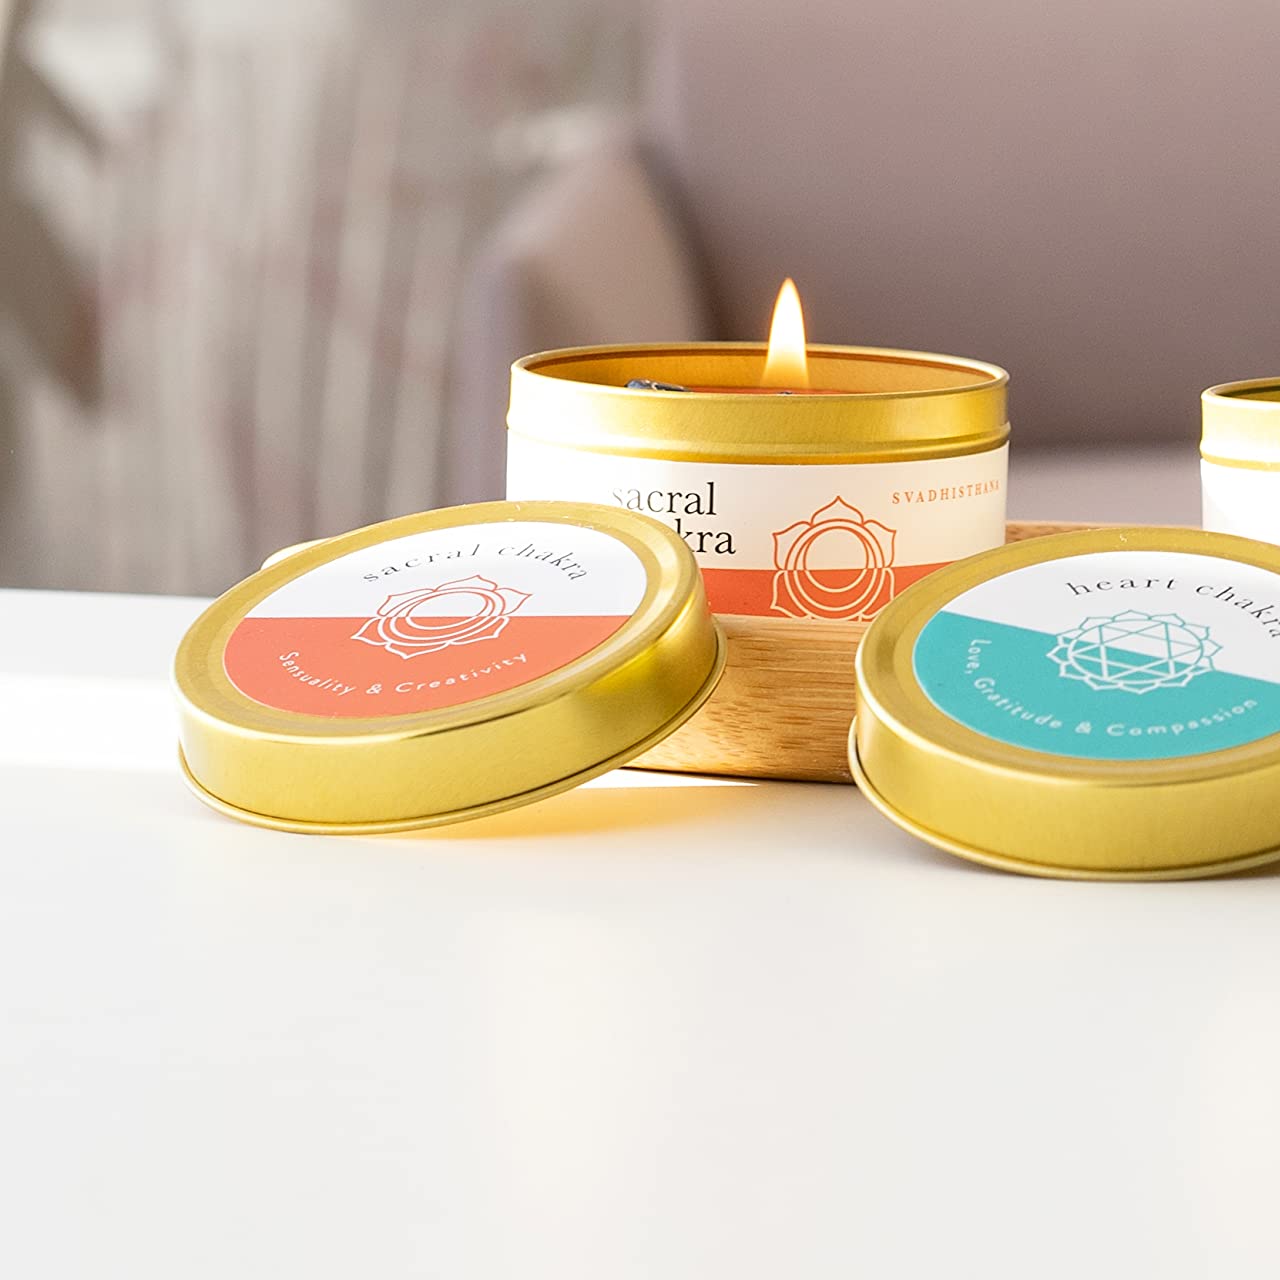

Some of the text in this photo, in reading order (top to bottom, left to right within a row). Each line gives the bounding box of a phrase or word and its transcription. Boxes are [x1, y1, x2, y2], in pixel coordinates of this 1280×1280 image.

[611, 481, 717, 516] sacral
[891, 479, 1000, 505] SVADHISTHANA
[674, 517, 737, 555] kra
[362, 543, 588, 583] sacral chakra
[1065, 576, 1177, 596] heart
[279, 651, 528, 696] Sensuality & Creativity
[965, 637, 1259, 737] Love, Gratitude & Compassion
